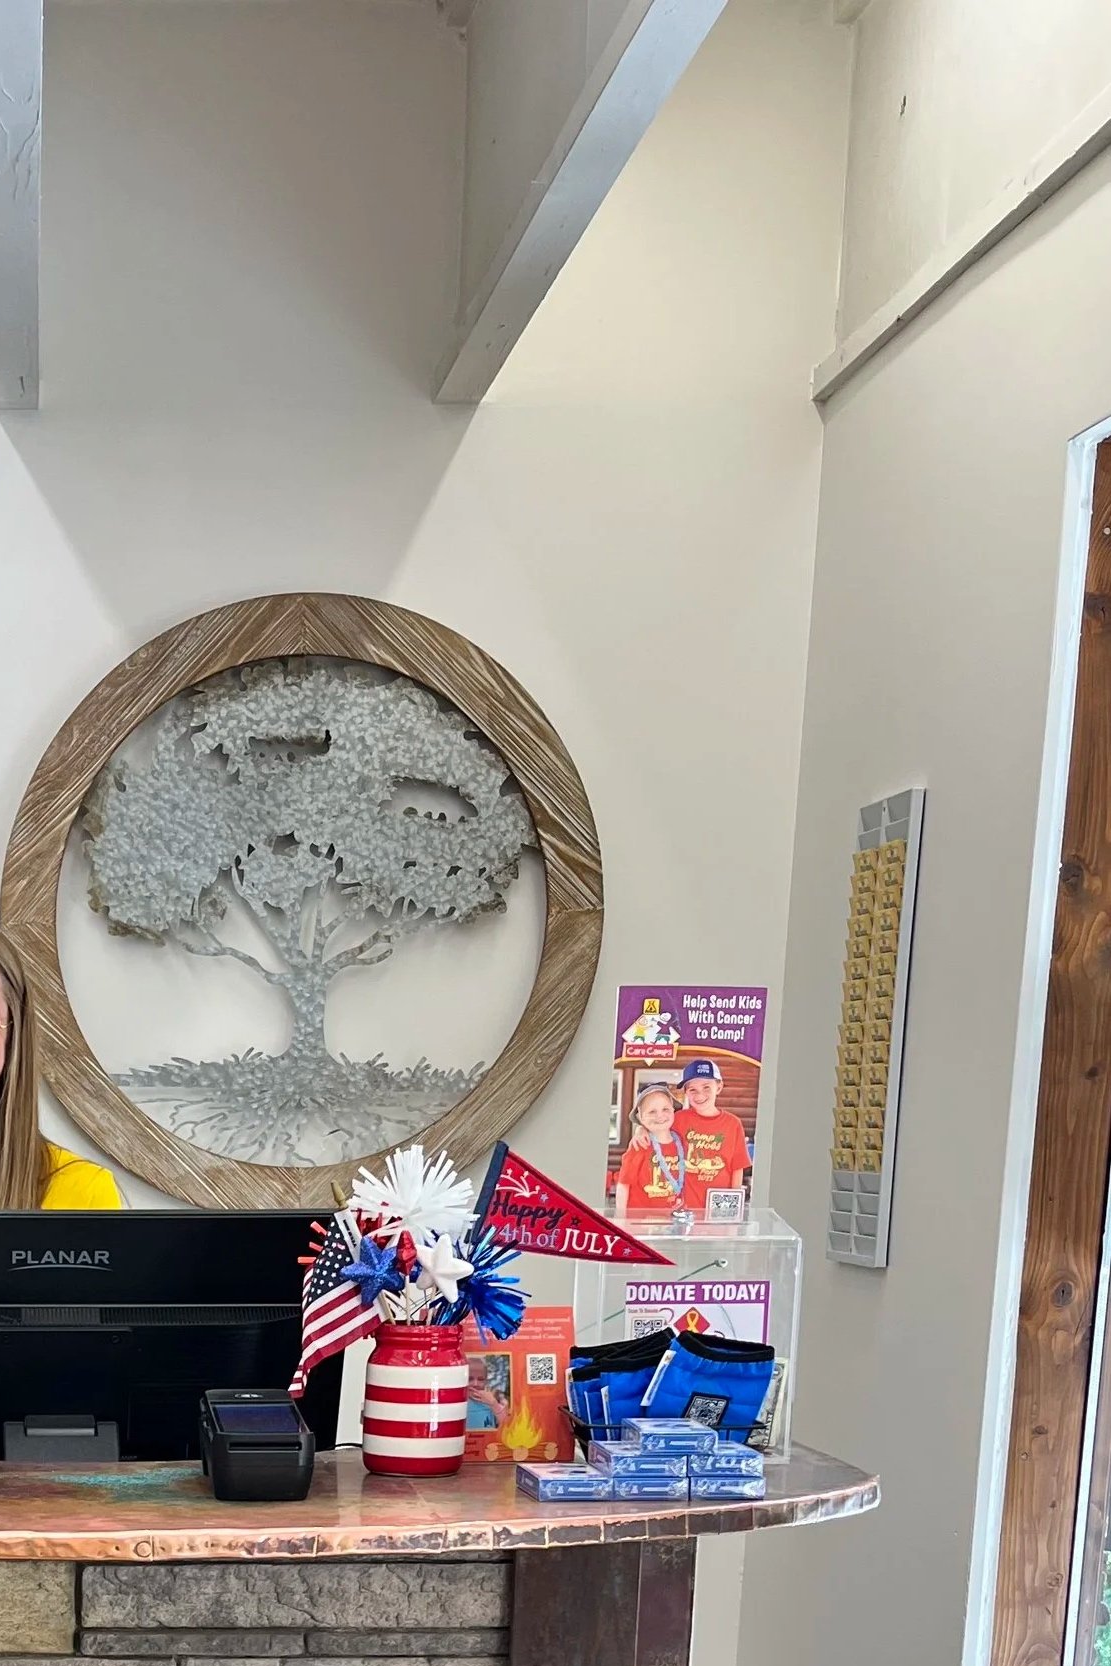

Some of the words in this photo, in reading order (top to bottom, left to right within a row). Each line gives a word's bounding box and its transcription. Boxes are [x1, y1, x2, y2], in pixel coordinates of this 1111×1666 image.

[683, 994, 708, 1010] Help
[709, 994, 736, 1009] Send
[738, 995, 762, 1009] Kids
[688, 1011, 715, 1024] With
[717, 1012, 755, 1025] Cancer
[696, 1027, 709, 1039] to
[711, 1026, 745, 1042] Camp!
[647, 1047, 672, 1057] Camps
[491, 1190, 567, 1230] Happy
[499, 1224, 532, 1246] 4th
[536, 1228, 560, 1248] of
[560, 1227, 621, 1256] JULY
[11, 1250, 110, 1264] PLANAR
[626, 1284, 696, 1301] DONATE
[701, 1283, 765, 1300] TODAY!
